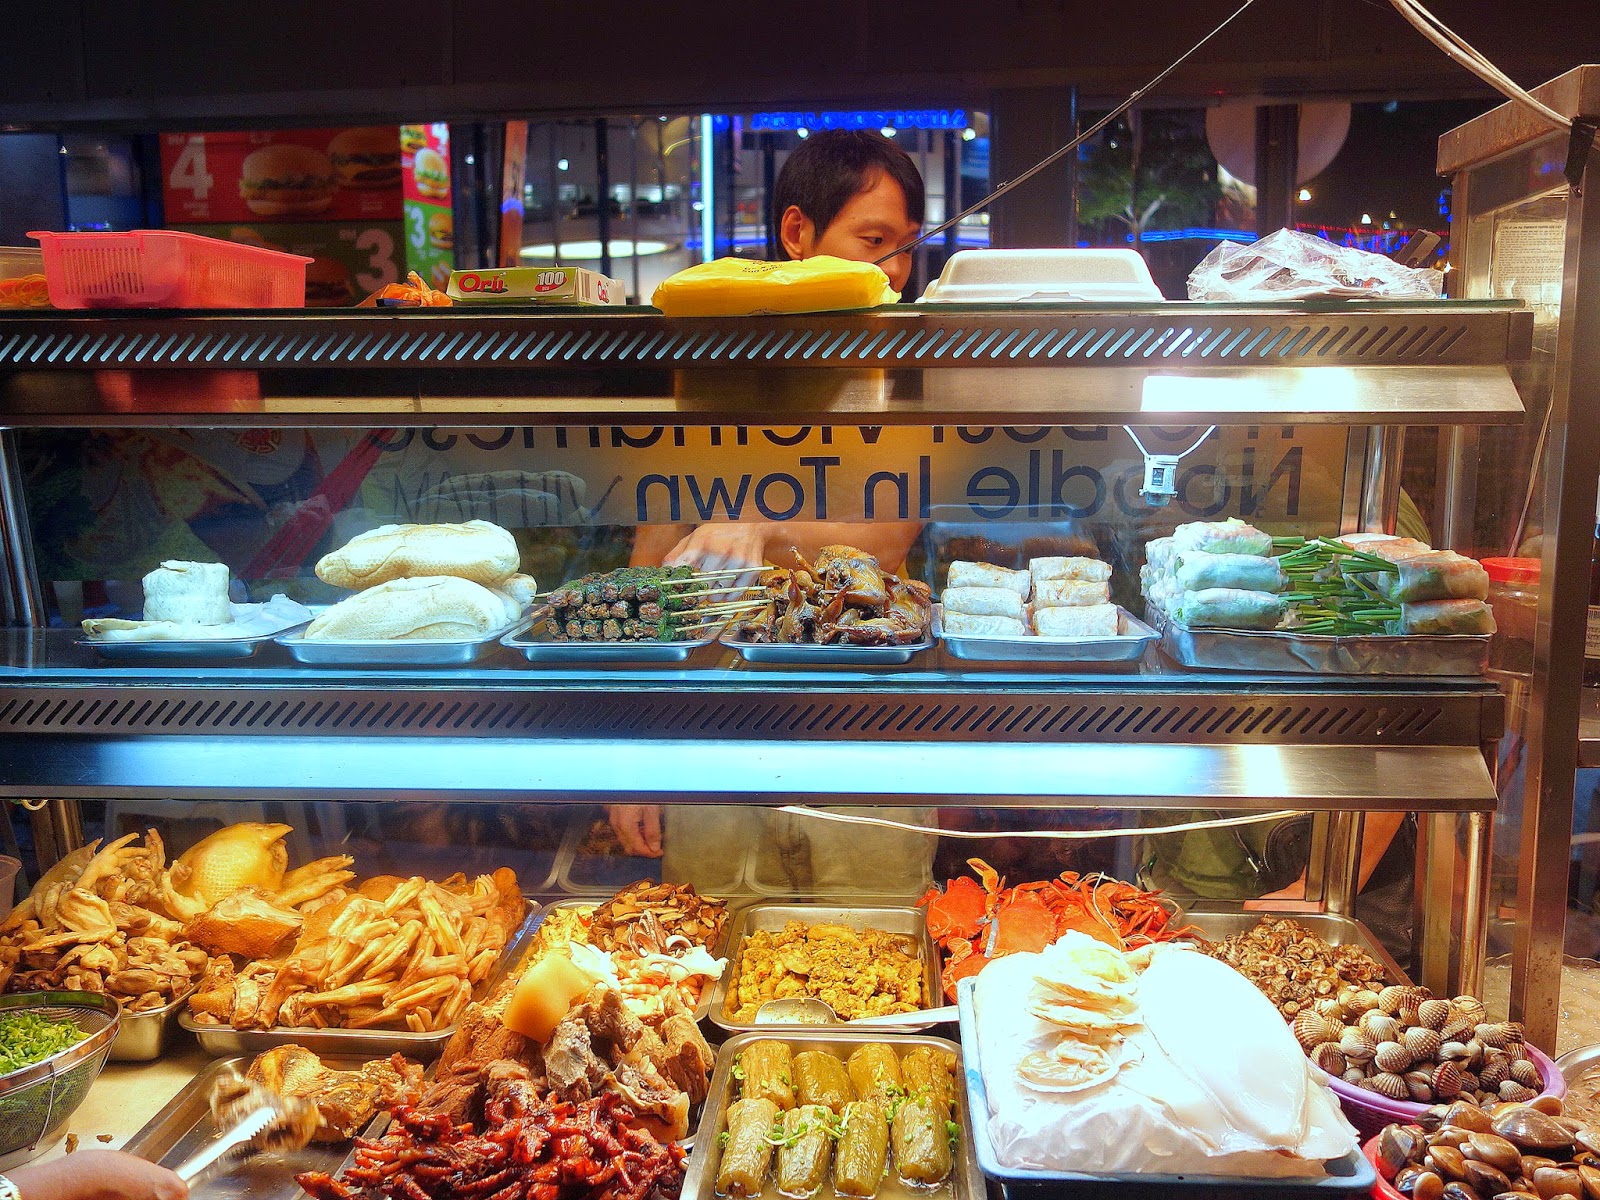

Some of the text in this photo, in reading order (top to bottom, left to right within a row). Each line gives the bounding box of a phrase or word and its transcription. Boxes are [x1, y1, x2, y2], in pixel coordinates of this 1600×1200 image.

[170, 136, 213, 199] 4
[410, 206, 426, 250] 3
[355, 229, 399, 294] 3
[537, 270, 566, 286] 100
